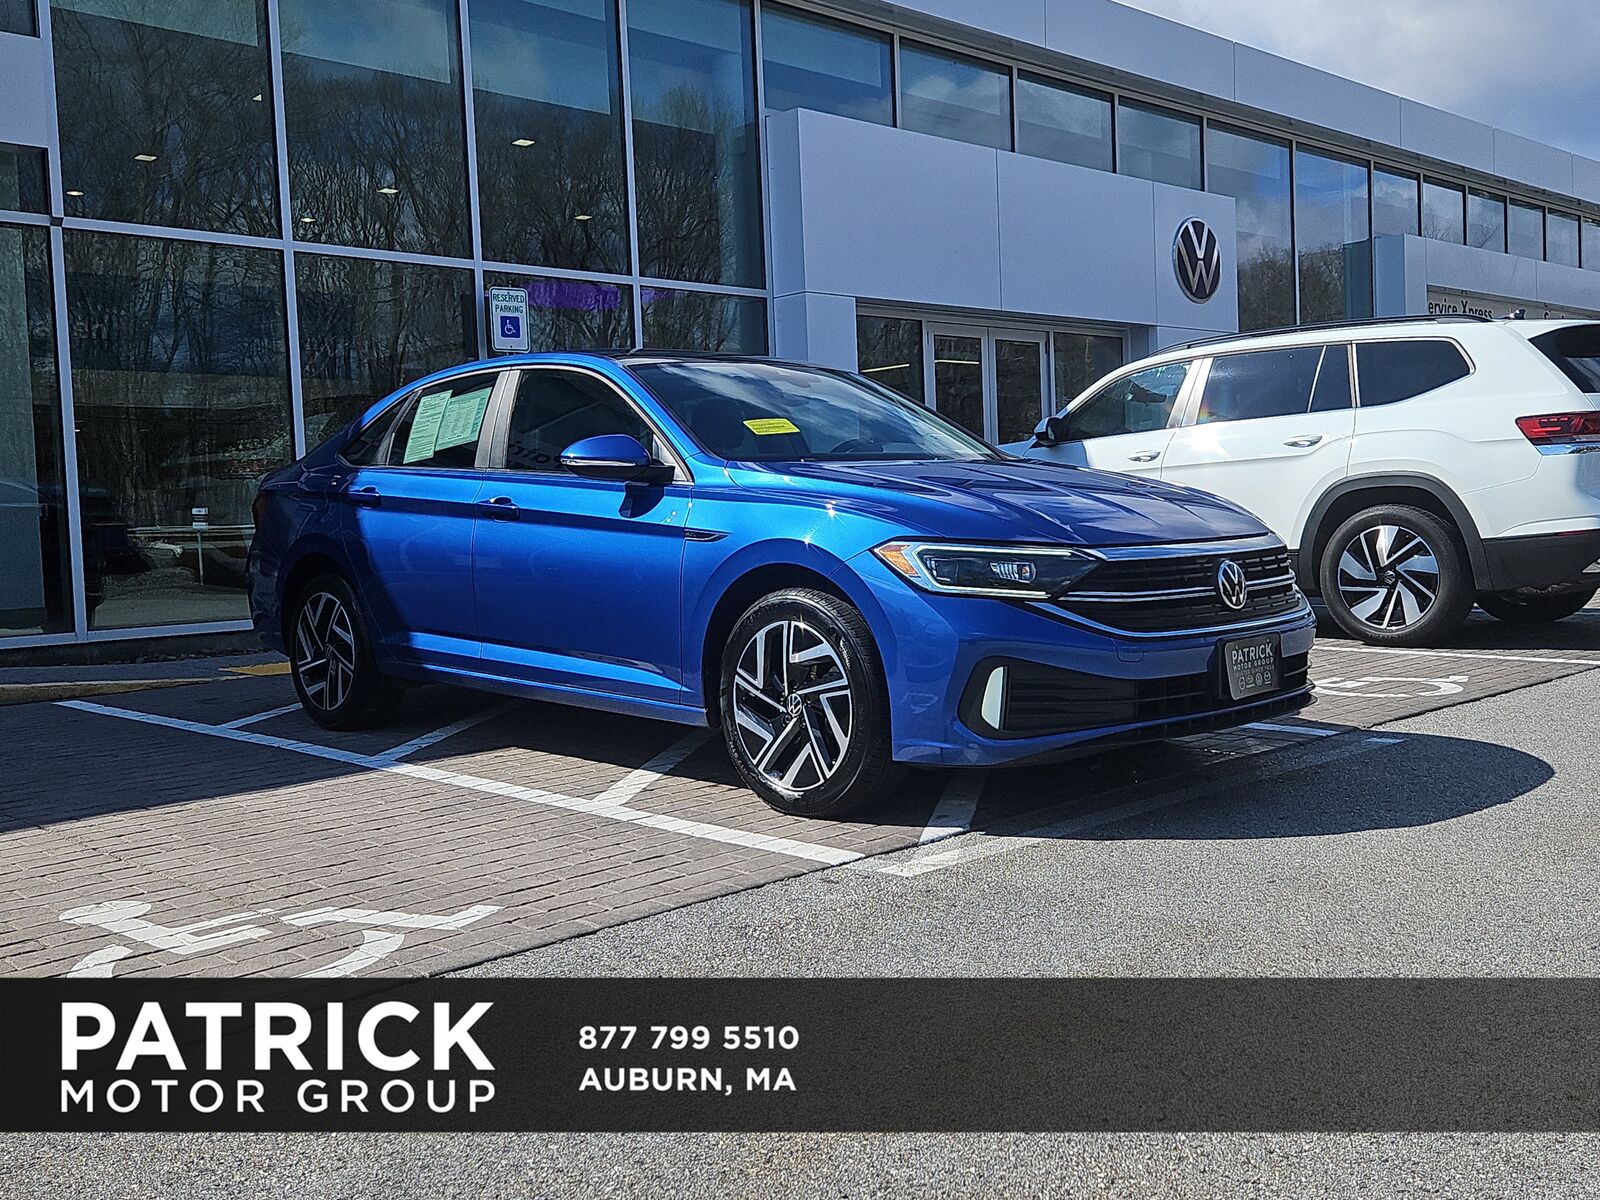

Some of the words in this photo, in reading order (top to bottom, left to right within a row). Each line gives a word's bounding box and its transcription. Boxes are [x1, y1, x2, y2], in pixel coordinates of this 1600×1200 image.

[492, 293, 525, 303] RESERVED
[494, 304, 524, 314] PARKING
[1428, 298, 1458, 314] ervice
[1231, 643, 1273, 665] PATRICK
[1233, 661, 1252, 671] MOTOR
[1254, 657, 1274, 667] GROUP
